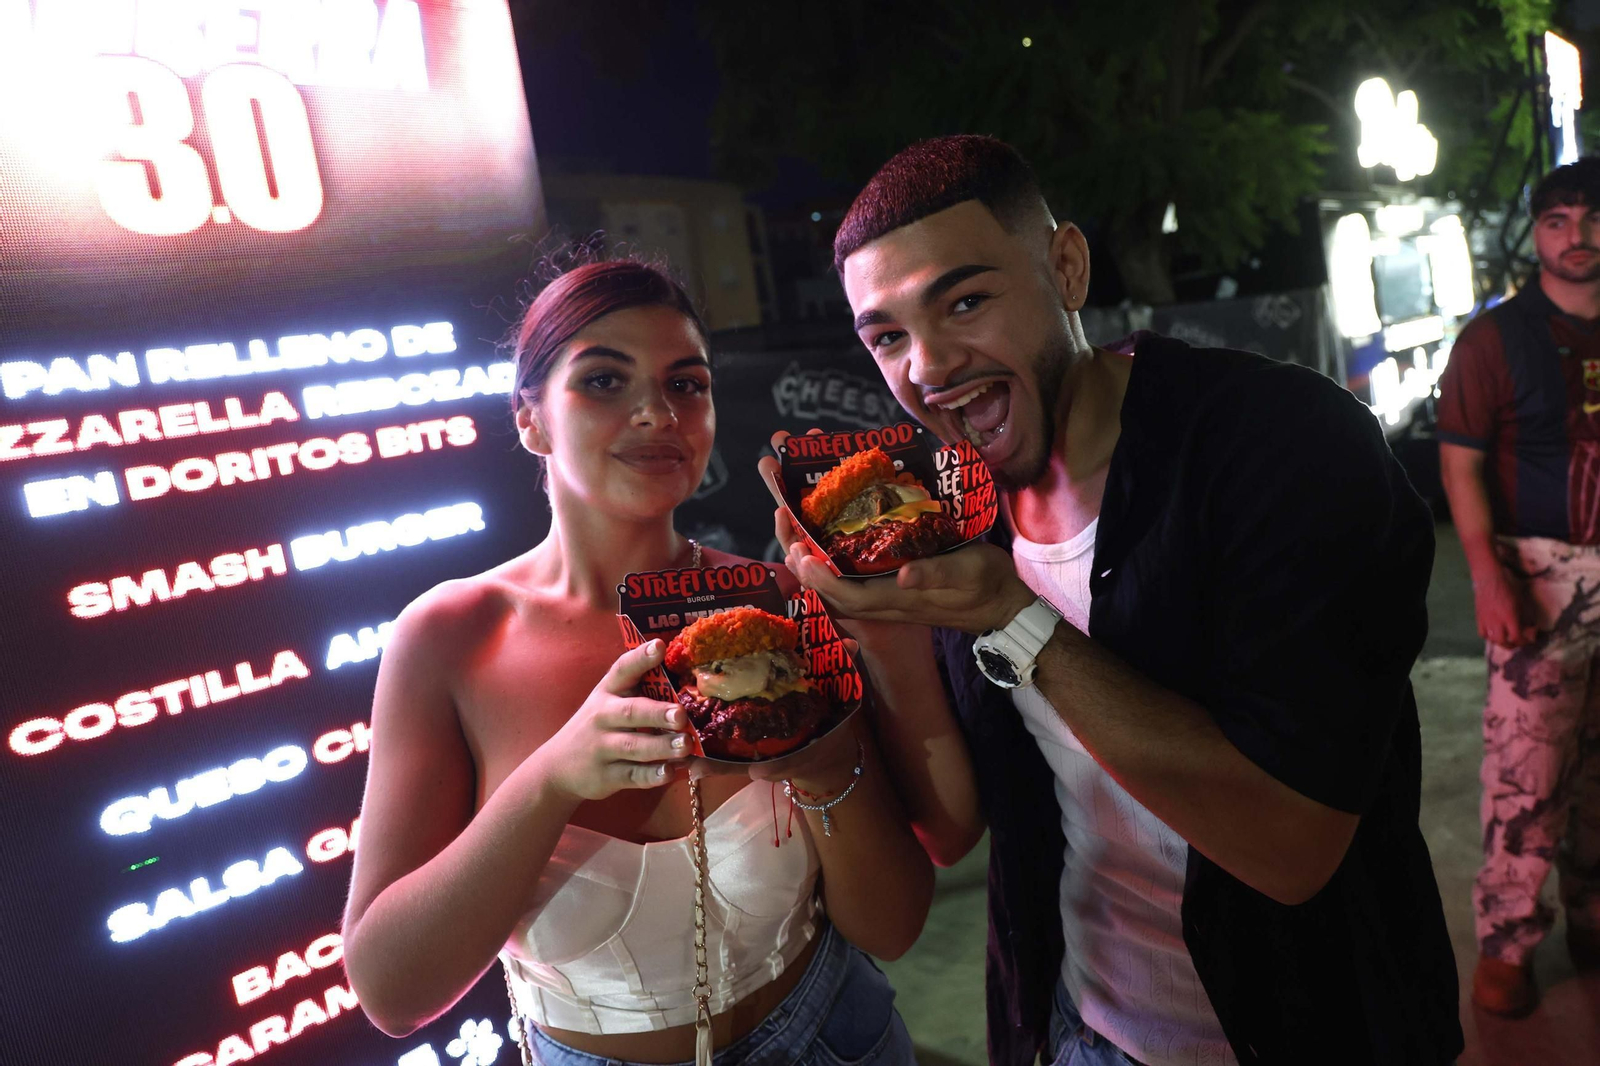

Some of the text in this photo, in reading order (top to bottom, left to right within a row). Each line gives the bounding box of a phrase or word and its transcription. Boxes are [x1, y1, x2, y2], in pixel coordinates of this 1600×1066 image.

[1, 321, 457, 399] PAN RELLENO DE
[779, 375, 899, 418] CHEESY
[0, 392, 299, 461] ZZARELLA
[786, 423, 914, 457] STREET FOOD
[23, 416, 478, 518] EN DORITOS BITS
[67, 501, 486, 619] SMASH BURGER
[625, 564, 766, 598] STREET FOOD
[686, 594, 716, 604] BURGER
[8, 650, 310, 756] COSTILLA
[100, 744, 308, 836] QUESO
[107, 846, 303, 943] SALSA
